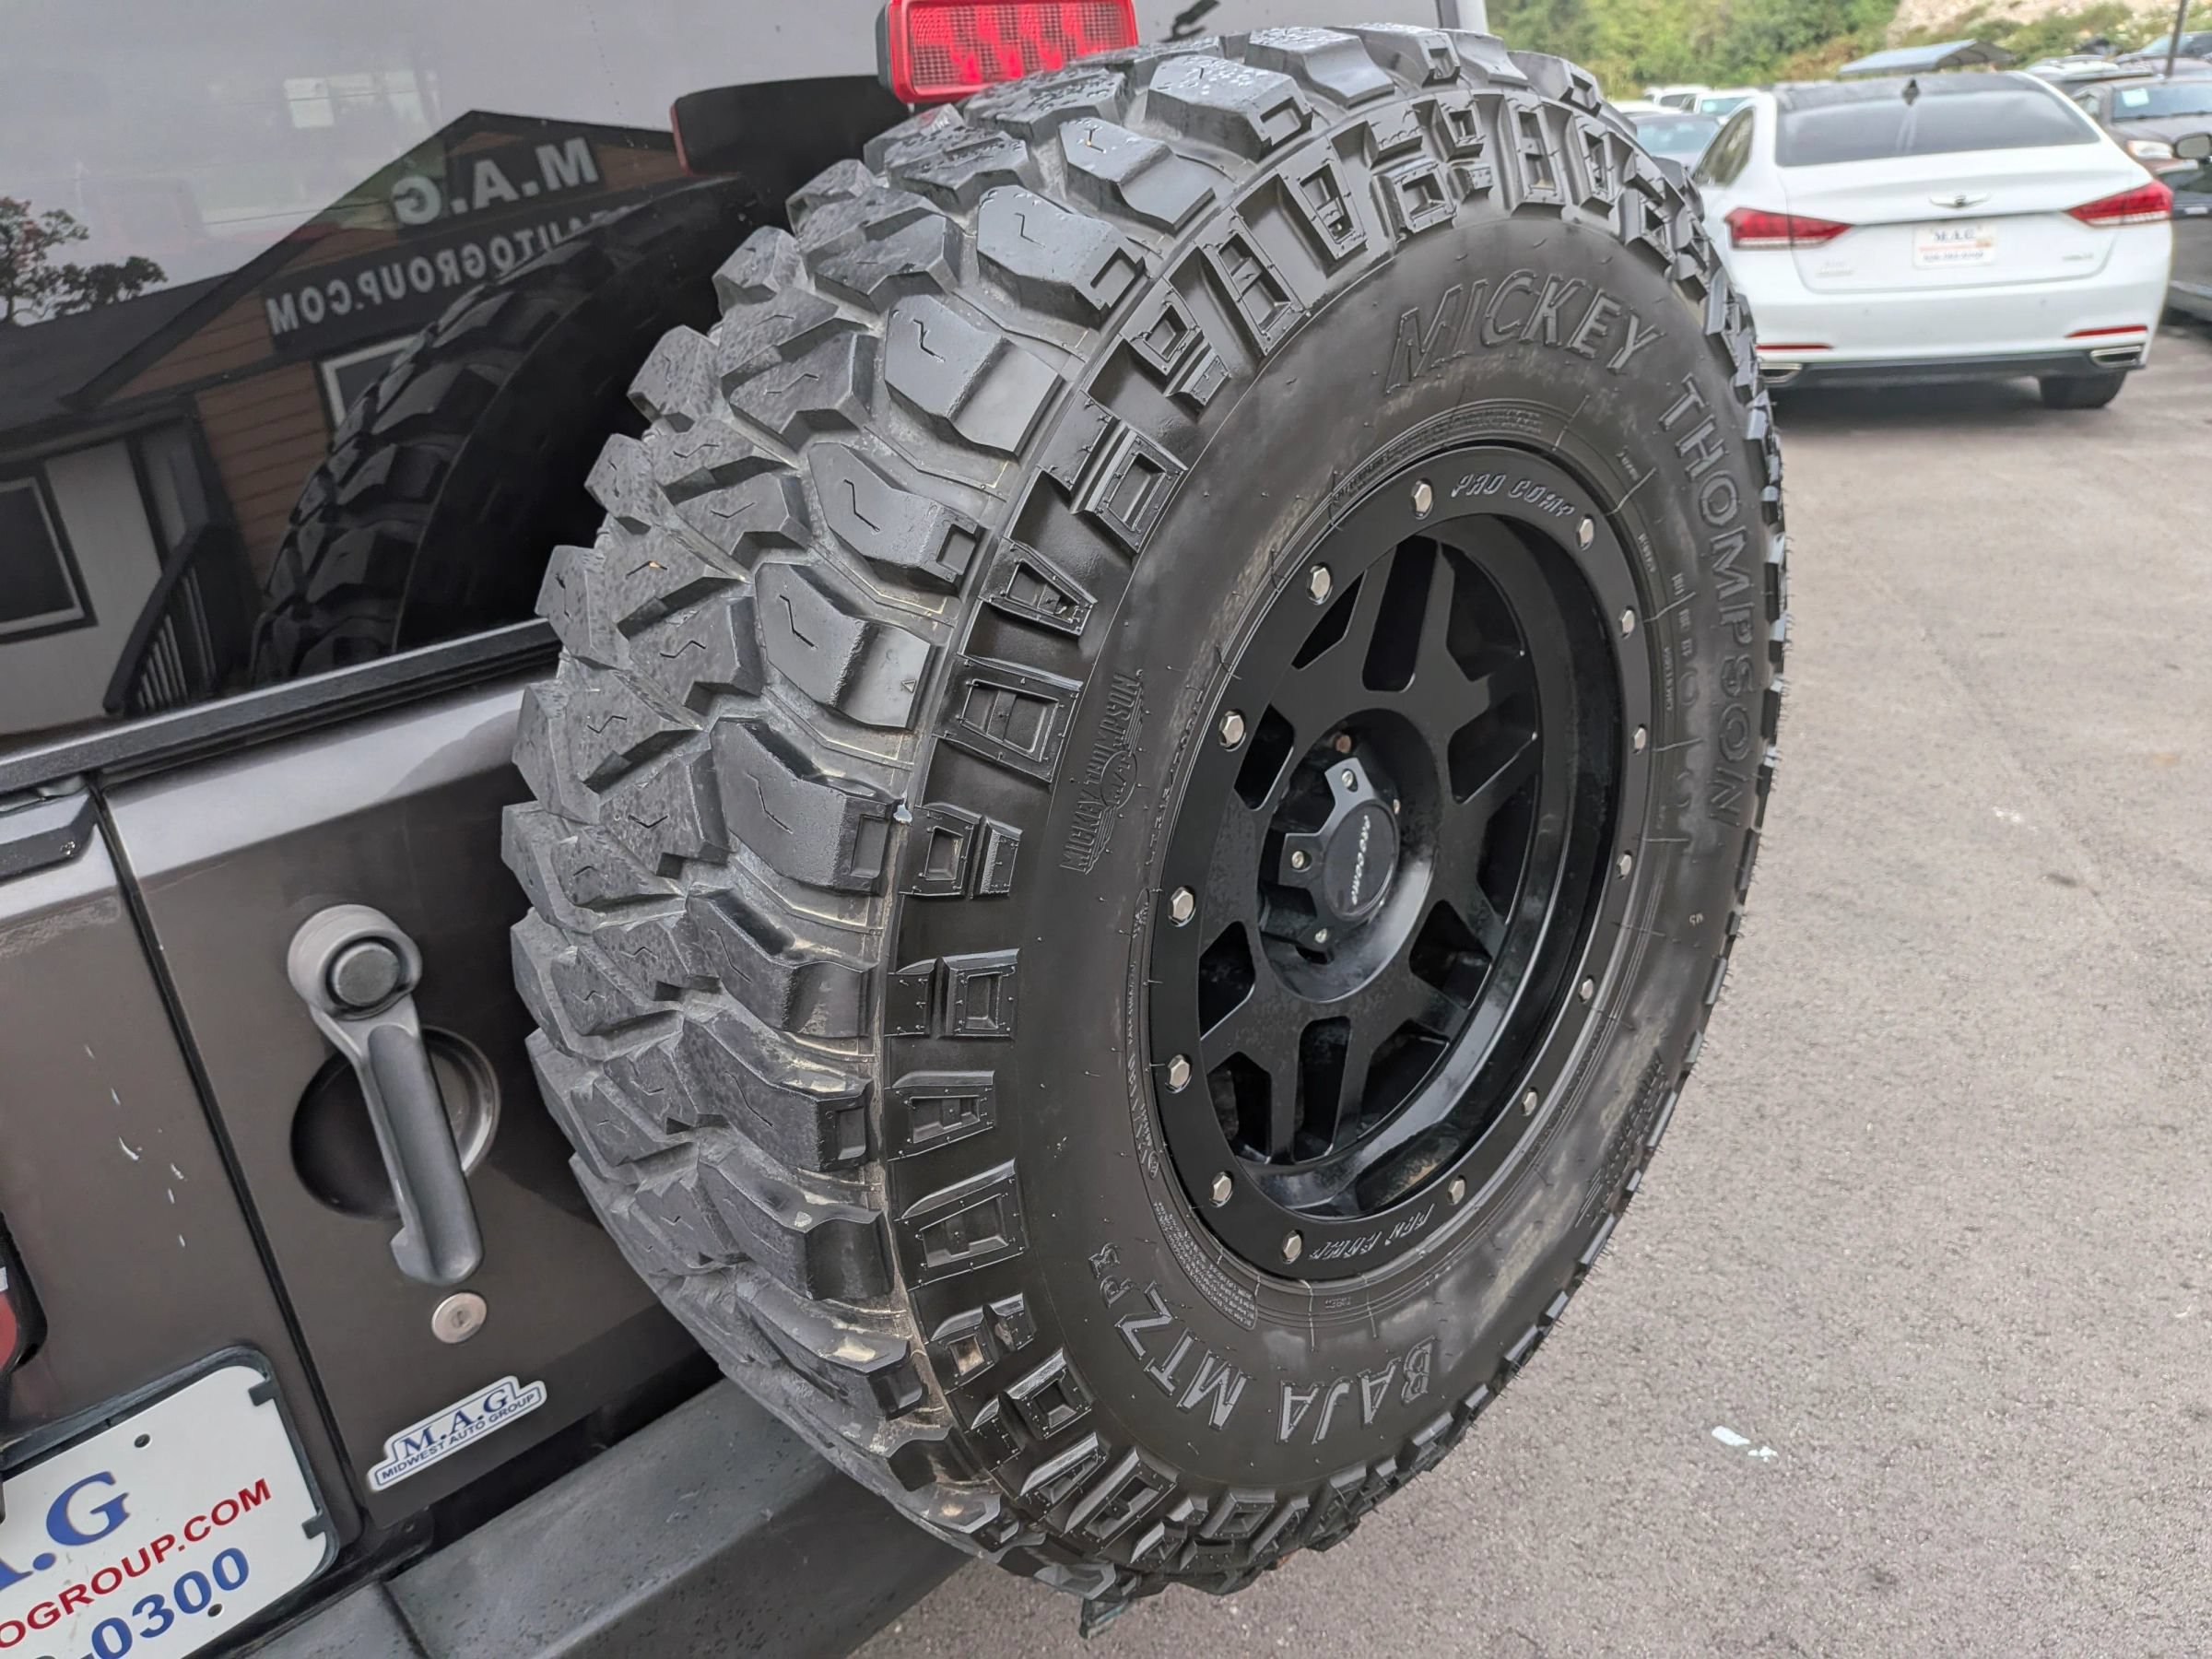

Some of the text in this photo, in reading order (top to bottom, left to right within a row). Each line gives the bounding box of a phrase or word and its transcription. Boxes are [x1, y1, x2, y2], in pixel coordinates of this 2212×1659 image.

[1385, 269, 1665, 394] MICKEY
[1659, 372, 1755, 828] THOMPSON
[1114, 1281, 1250, 1431] MTZ
[1277, 1335, 1438, 1444] BAJA
[382, 1394, 535, 1479] MIDWEST AUTO GROUP
[401, 1388, 509, 1459] M.A.G
[0, 1471, 131, 1591] .G
[34, 1547, 250, 1659] -0300
